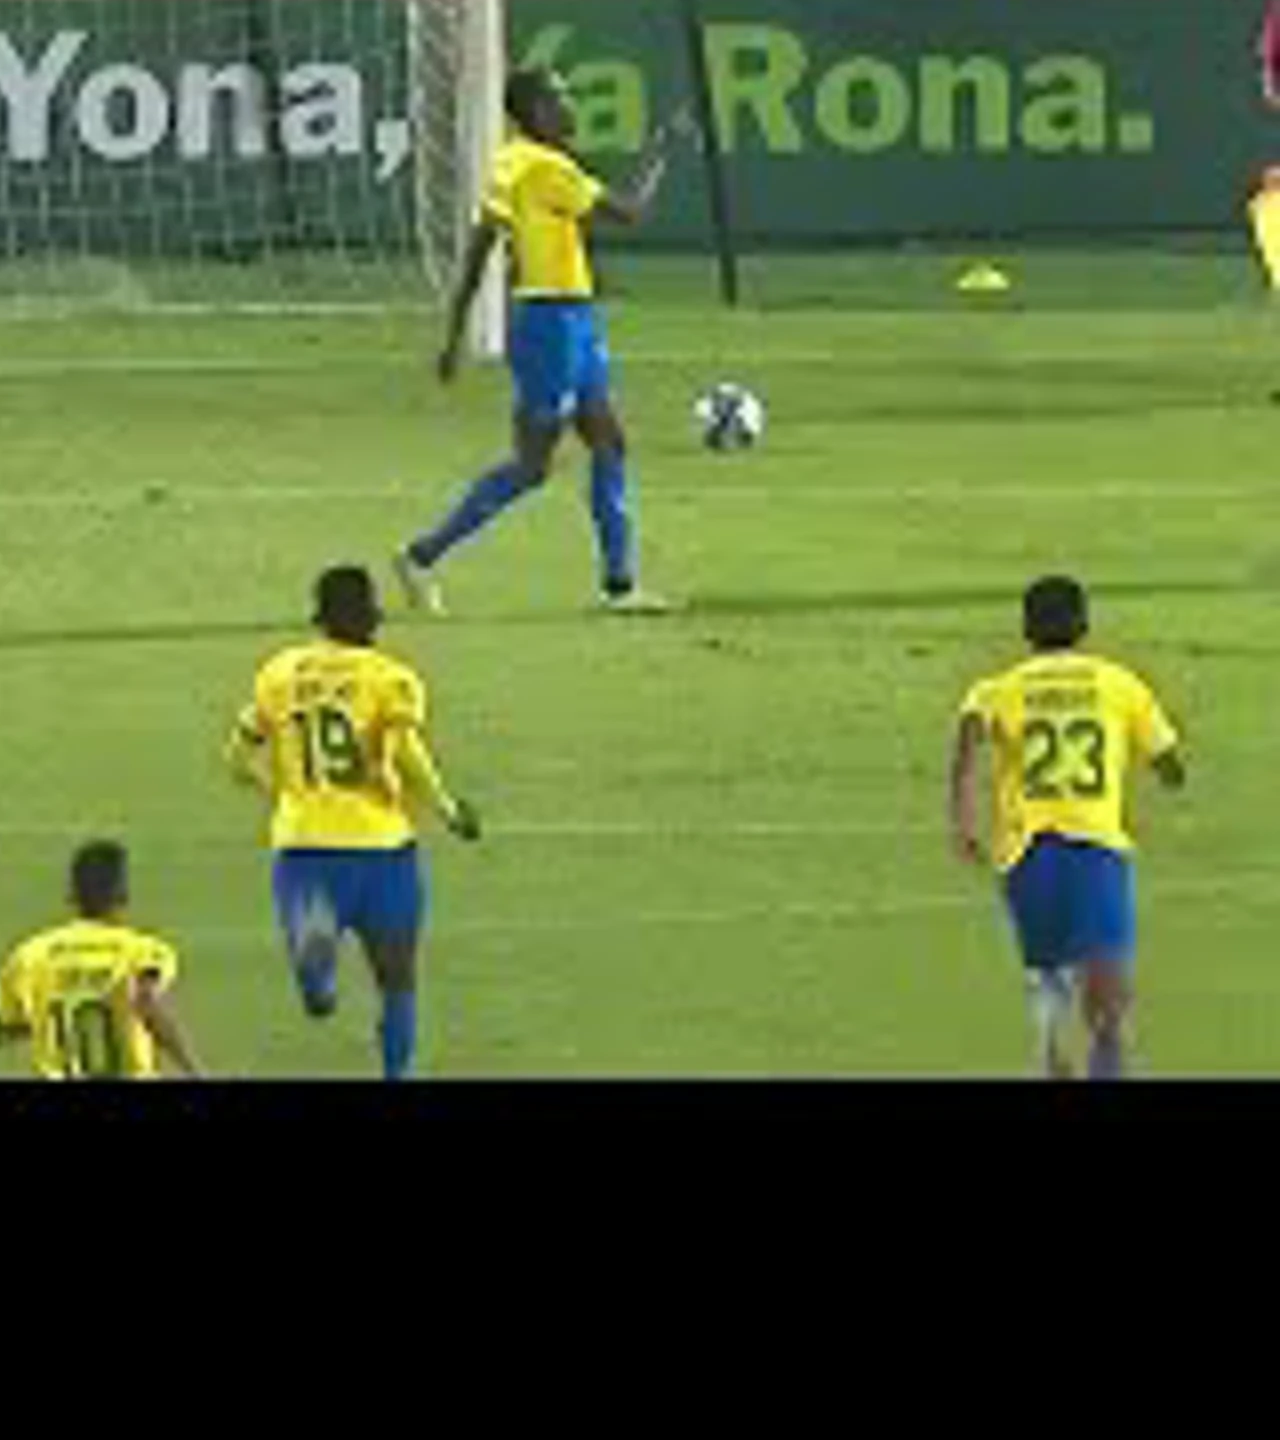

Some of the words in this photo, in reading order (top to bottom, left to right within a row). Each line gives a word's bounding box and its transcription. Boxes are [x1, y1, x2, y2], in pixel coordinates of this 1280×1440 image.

[701, 23, 1154, 153] Rona.
[293, 704, 368, 784] 19
[1025, 718, 1106, 800] 23
